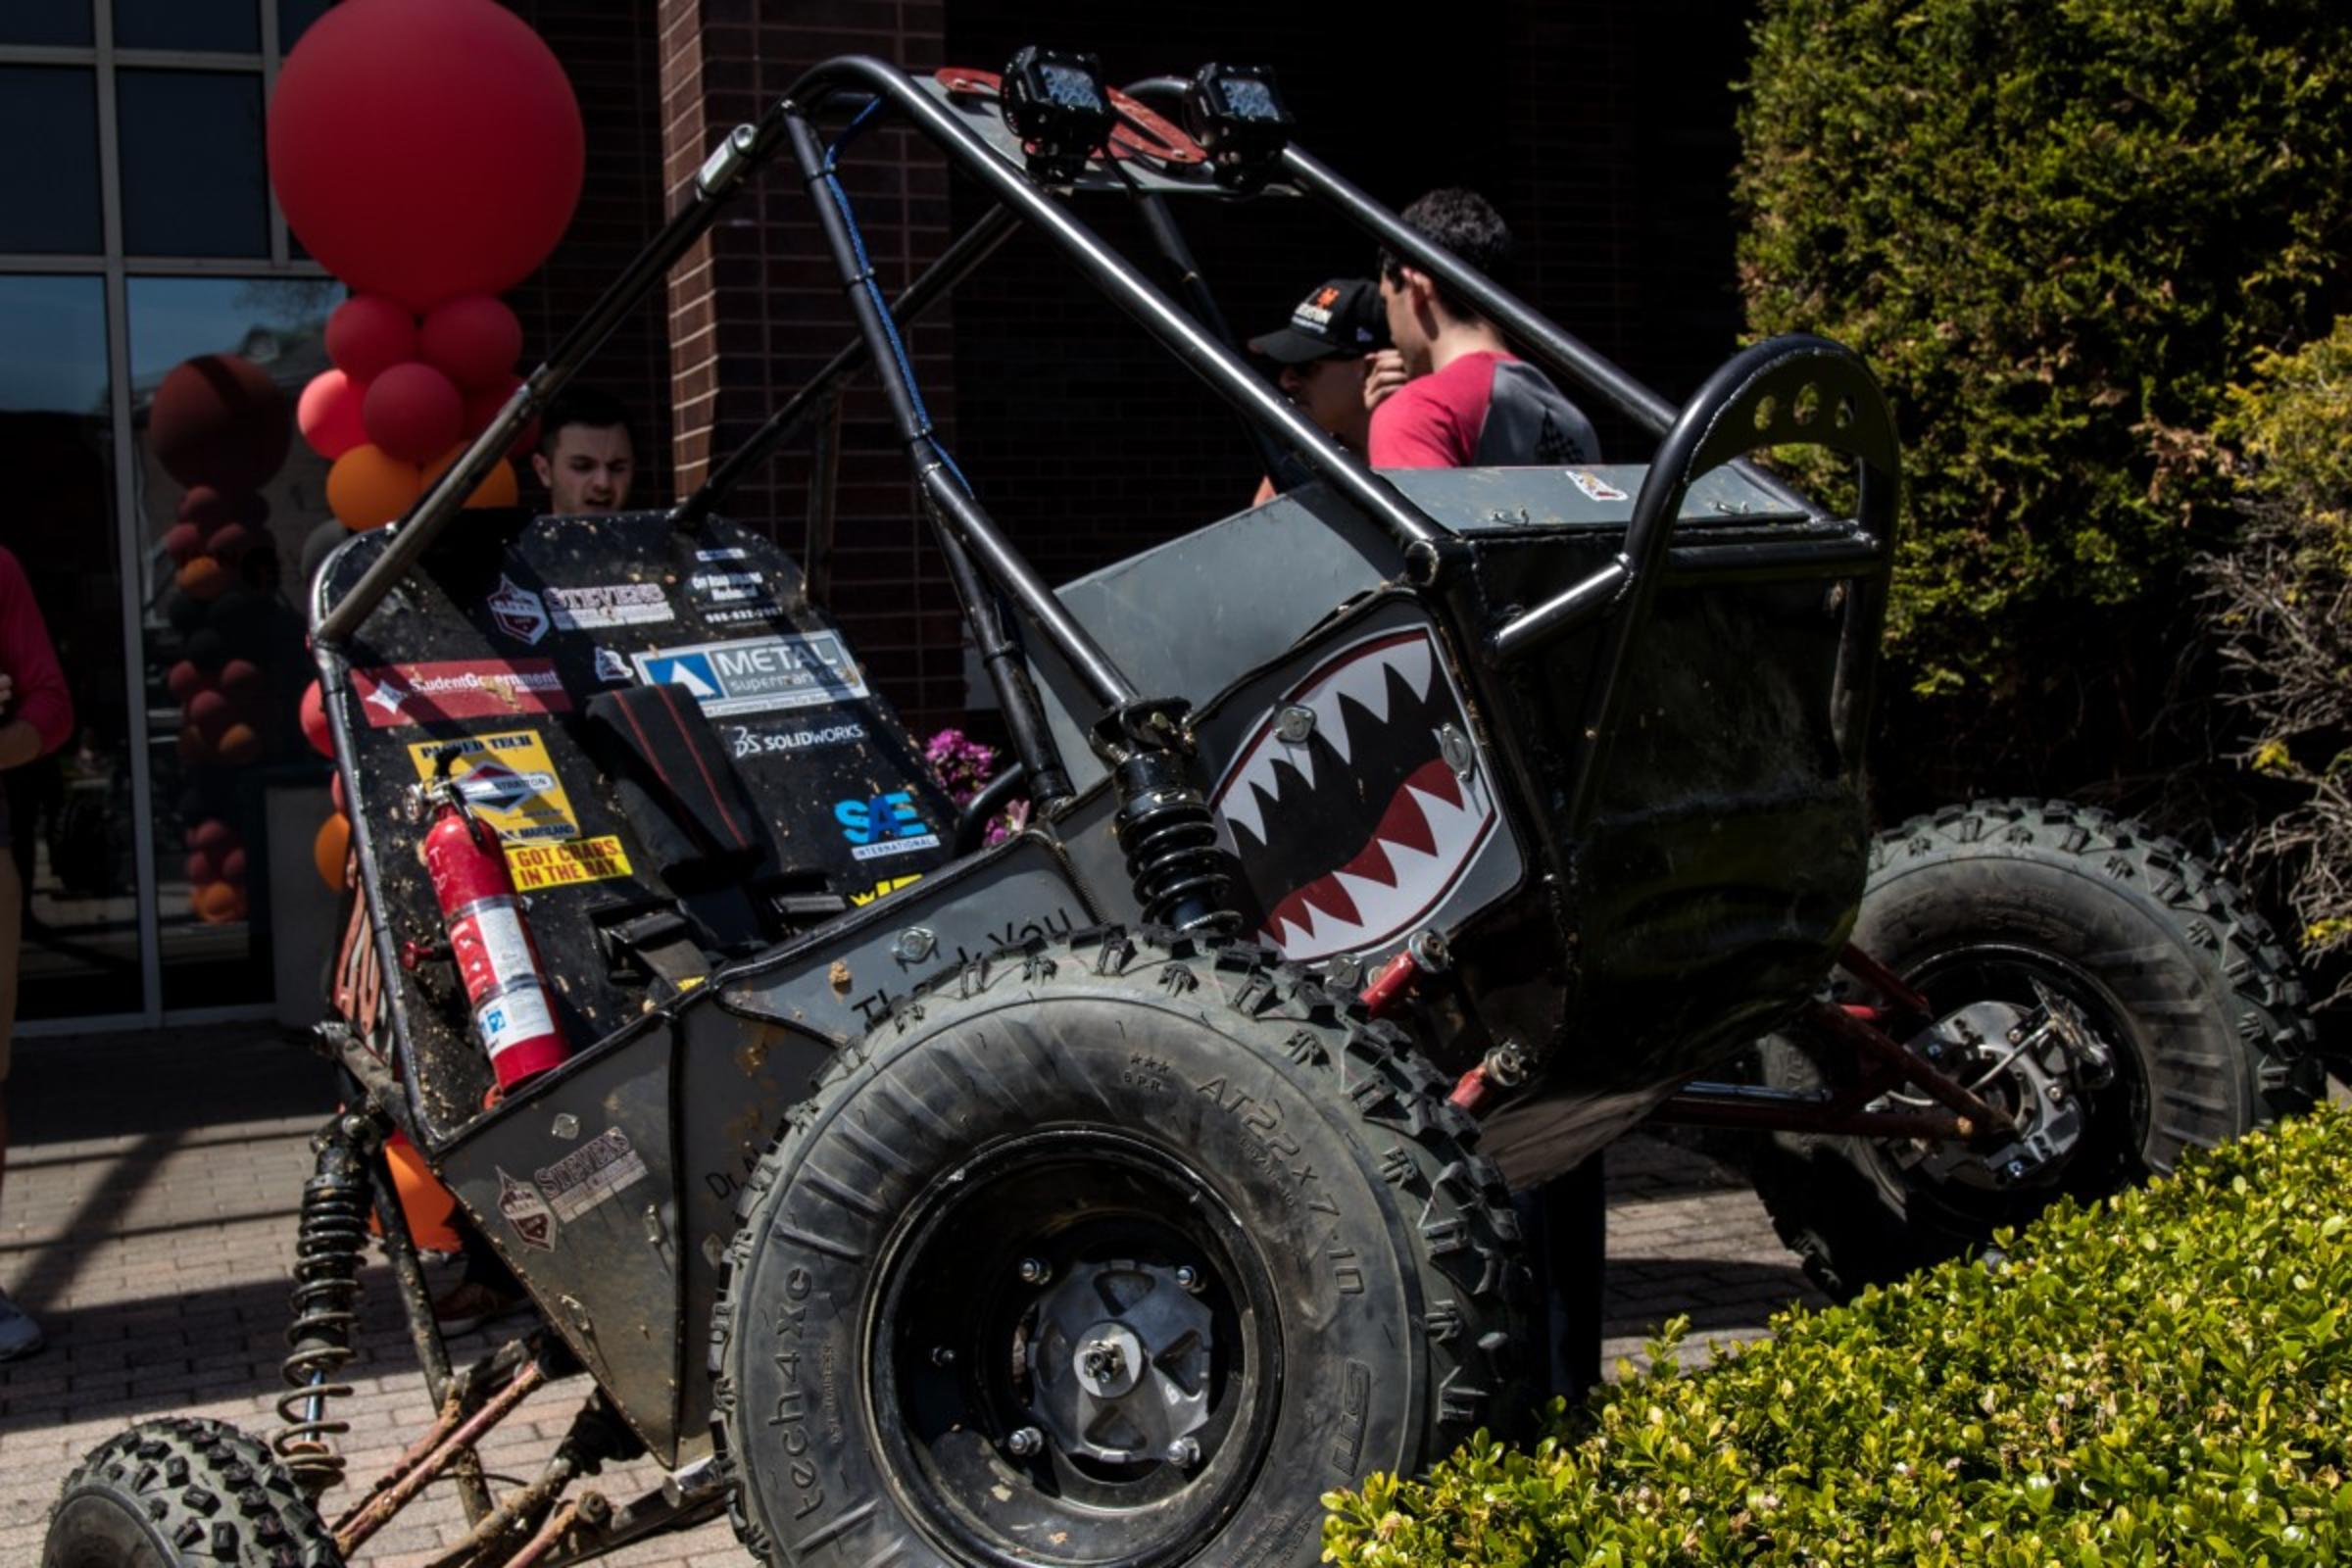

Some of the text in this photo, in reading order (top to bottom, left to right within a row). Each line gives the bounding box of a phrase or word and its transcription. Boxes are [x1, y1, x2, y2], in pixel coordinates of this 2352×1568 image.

[712, 642, 839, 676] METAL
[490, 735, 533, 751] TECH
[763, 723, 864, 751] SOLIDWORKS
[833, 791, 927, 843] SAE
[517, 846, 553, 868] GOT
[558, 839, 620, 862] CRABS
[854, 835, 938, 859] INTERNATIONAL
[518, 868, 544, 888] IN
[548, 863, 581, 884] THE
